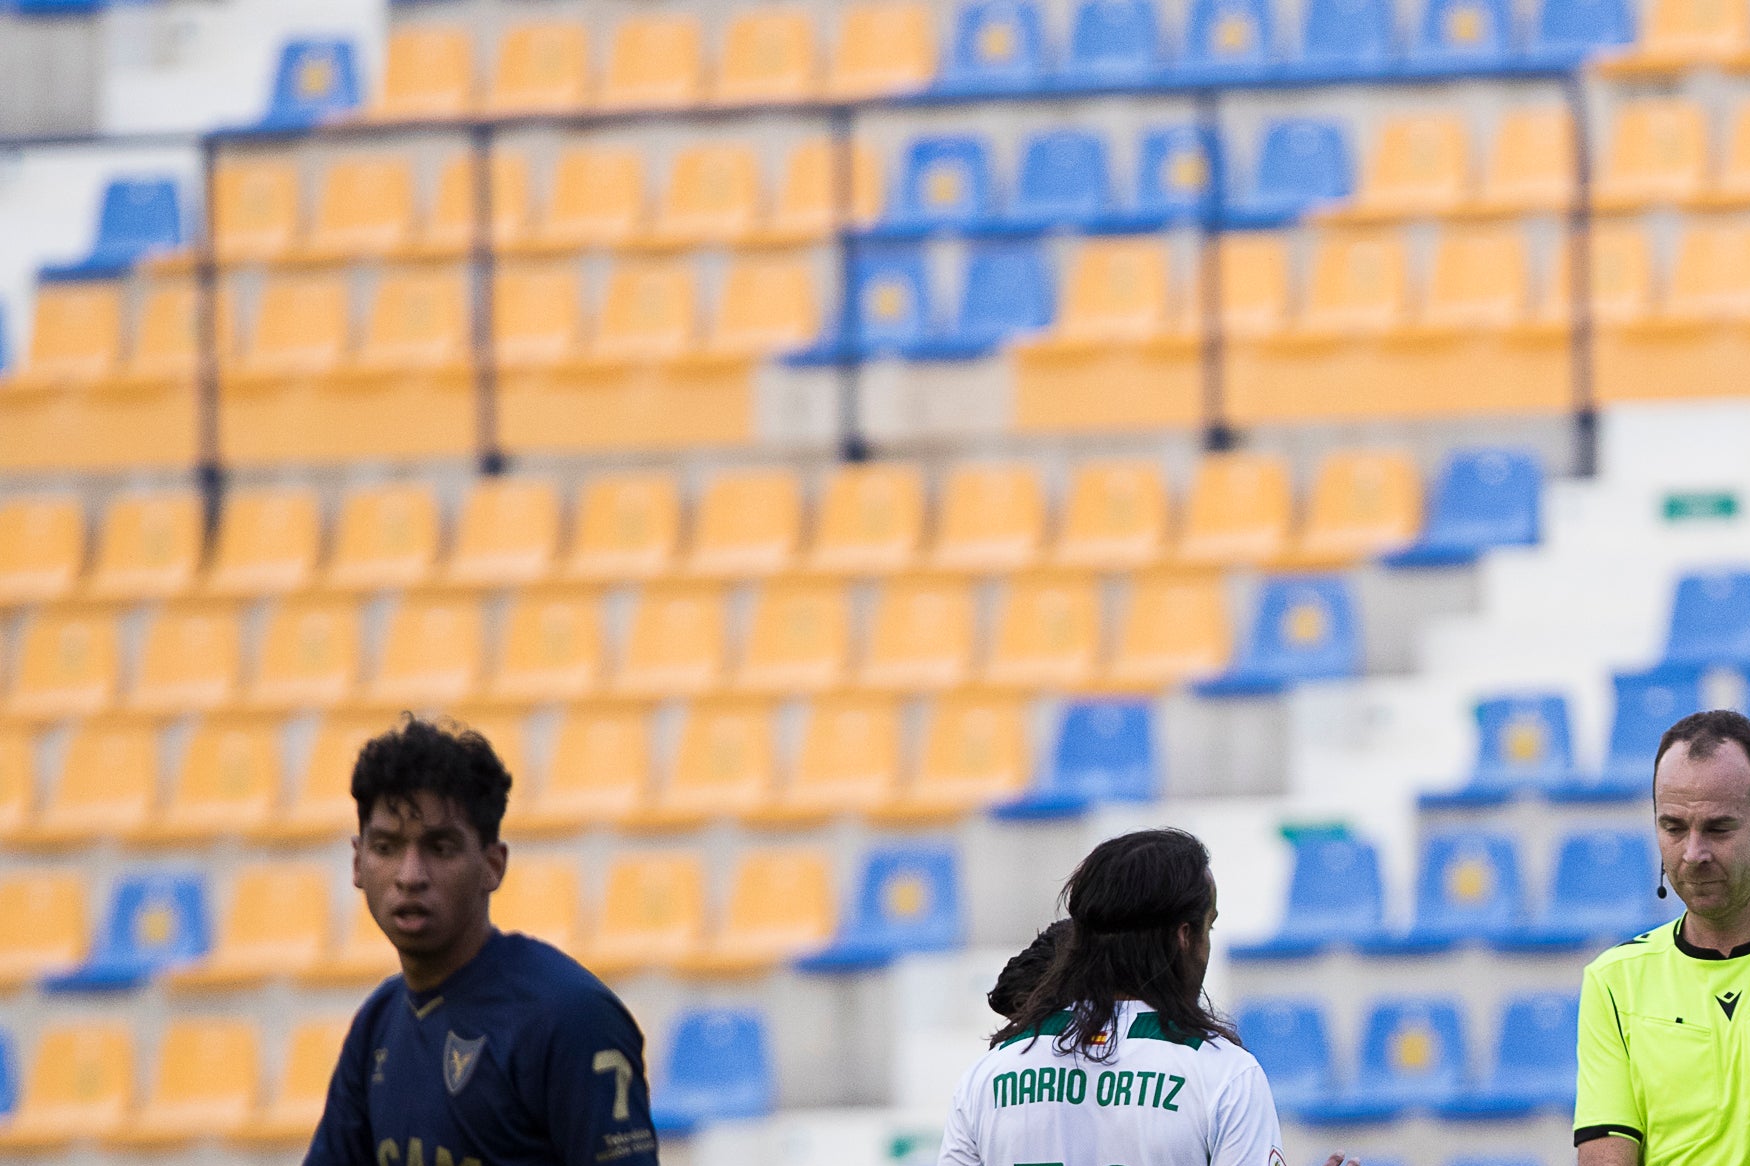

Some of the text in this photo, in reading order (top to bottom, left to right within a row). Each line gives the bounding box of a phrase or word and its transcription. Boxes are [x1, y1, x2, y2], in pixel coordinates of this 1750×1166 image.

[592, 1049, 632, 1121] 7
[993, 1067, 1185, 1112] MARIO ORTIZ
